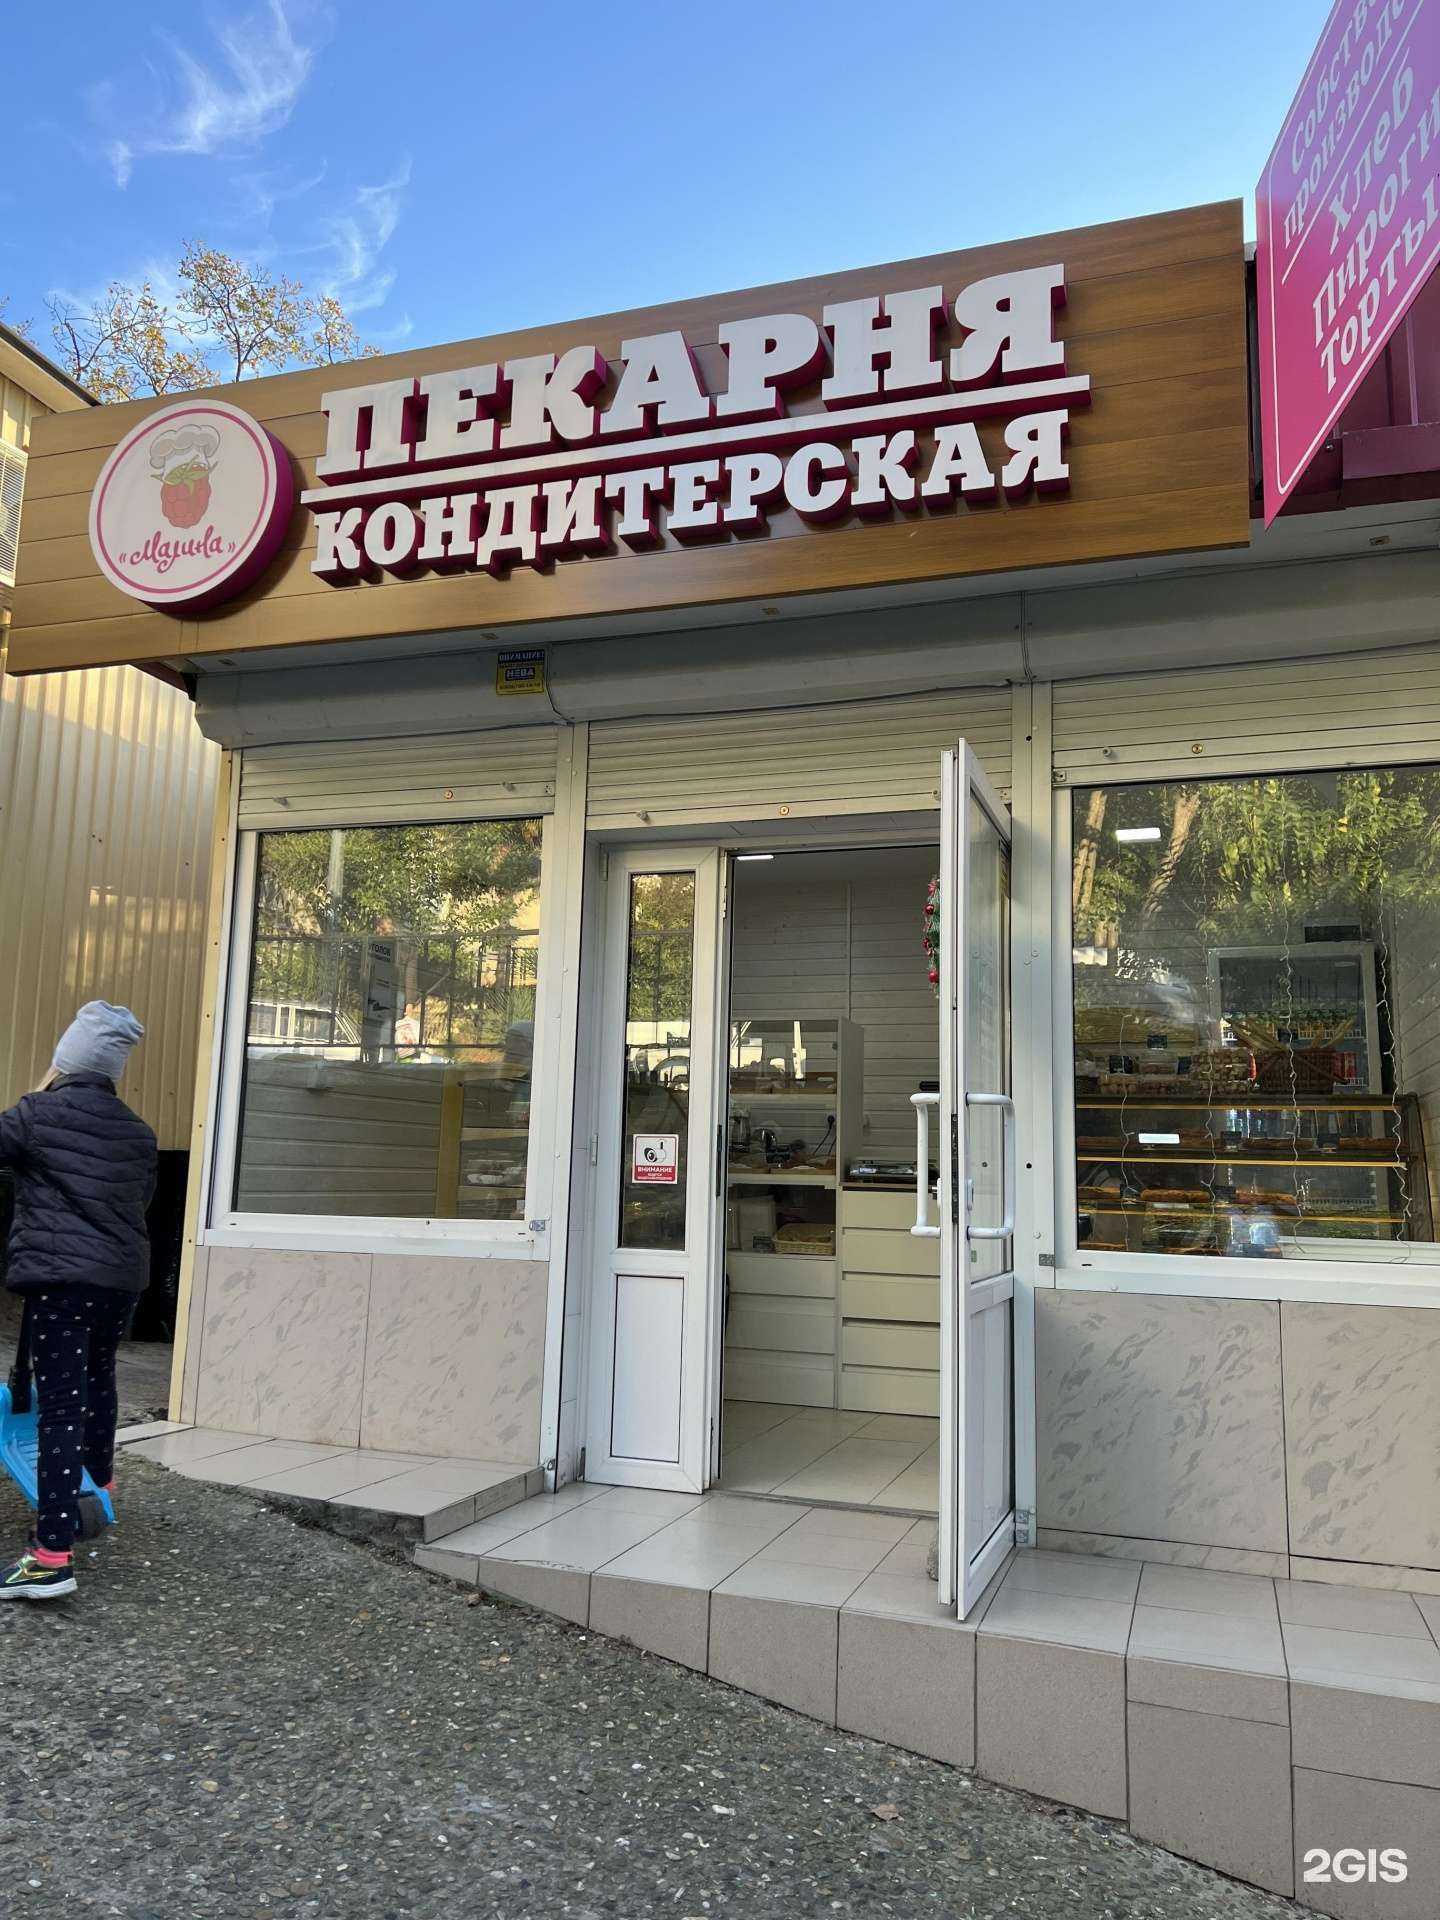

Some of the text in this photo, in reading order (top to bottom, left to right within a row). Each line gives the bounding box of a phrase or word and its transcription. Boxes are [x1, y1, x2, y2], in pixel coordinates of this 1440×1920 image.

[1292, 0, 1377, 175] Собств
[1329, 46, 1414, 256] Хлеб
[1312, 87, 1440, 348] Пироги
[1320, 175, 1439, 394] Торты
[316, 264, 1066, 478] ПЕКАРНЯ
[310, 408, 1070, 574] КОНДИТЕРСКАЯ
